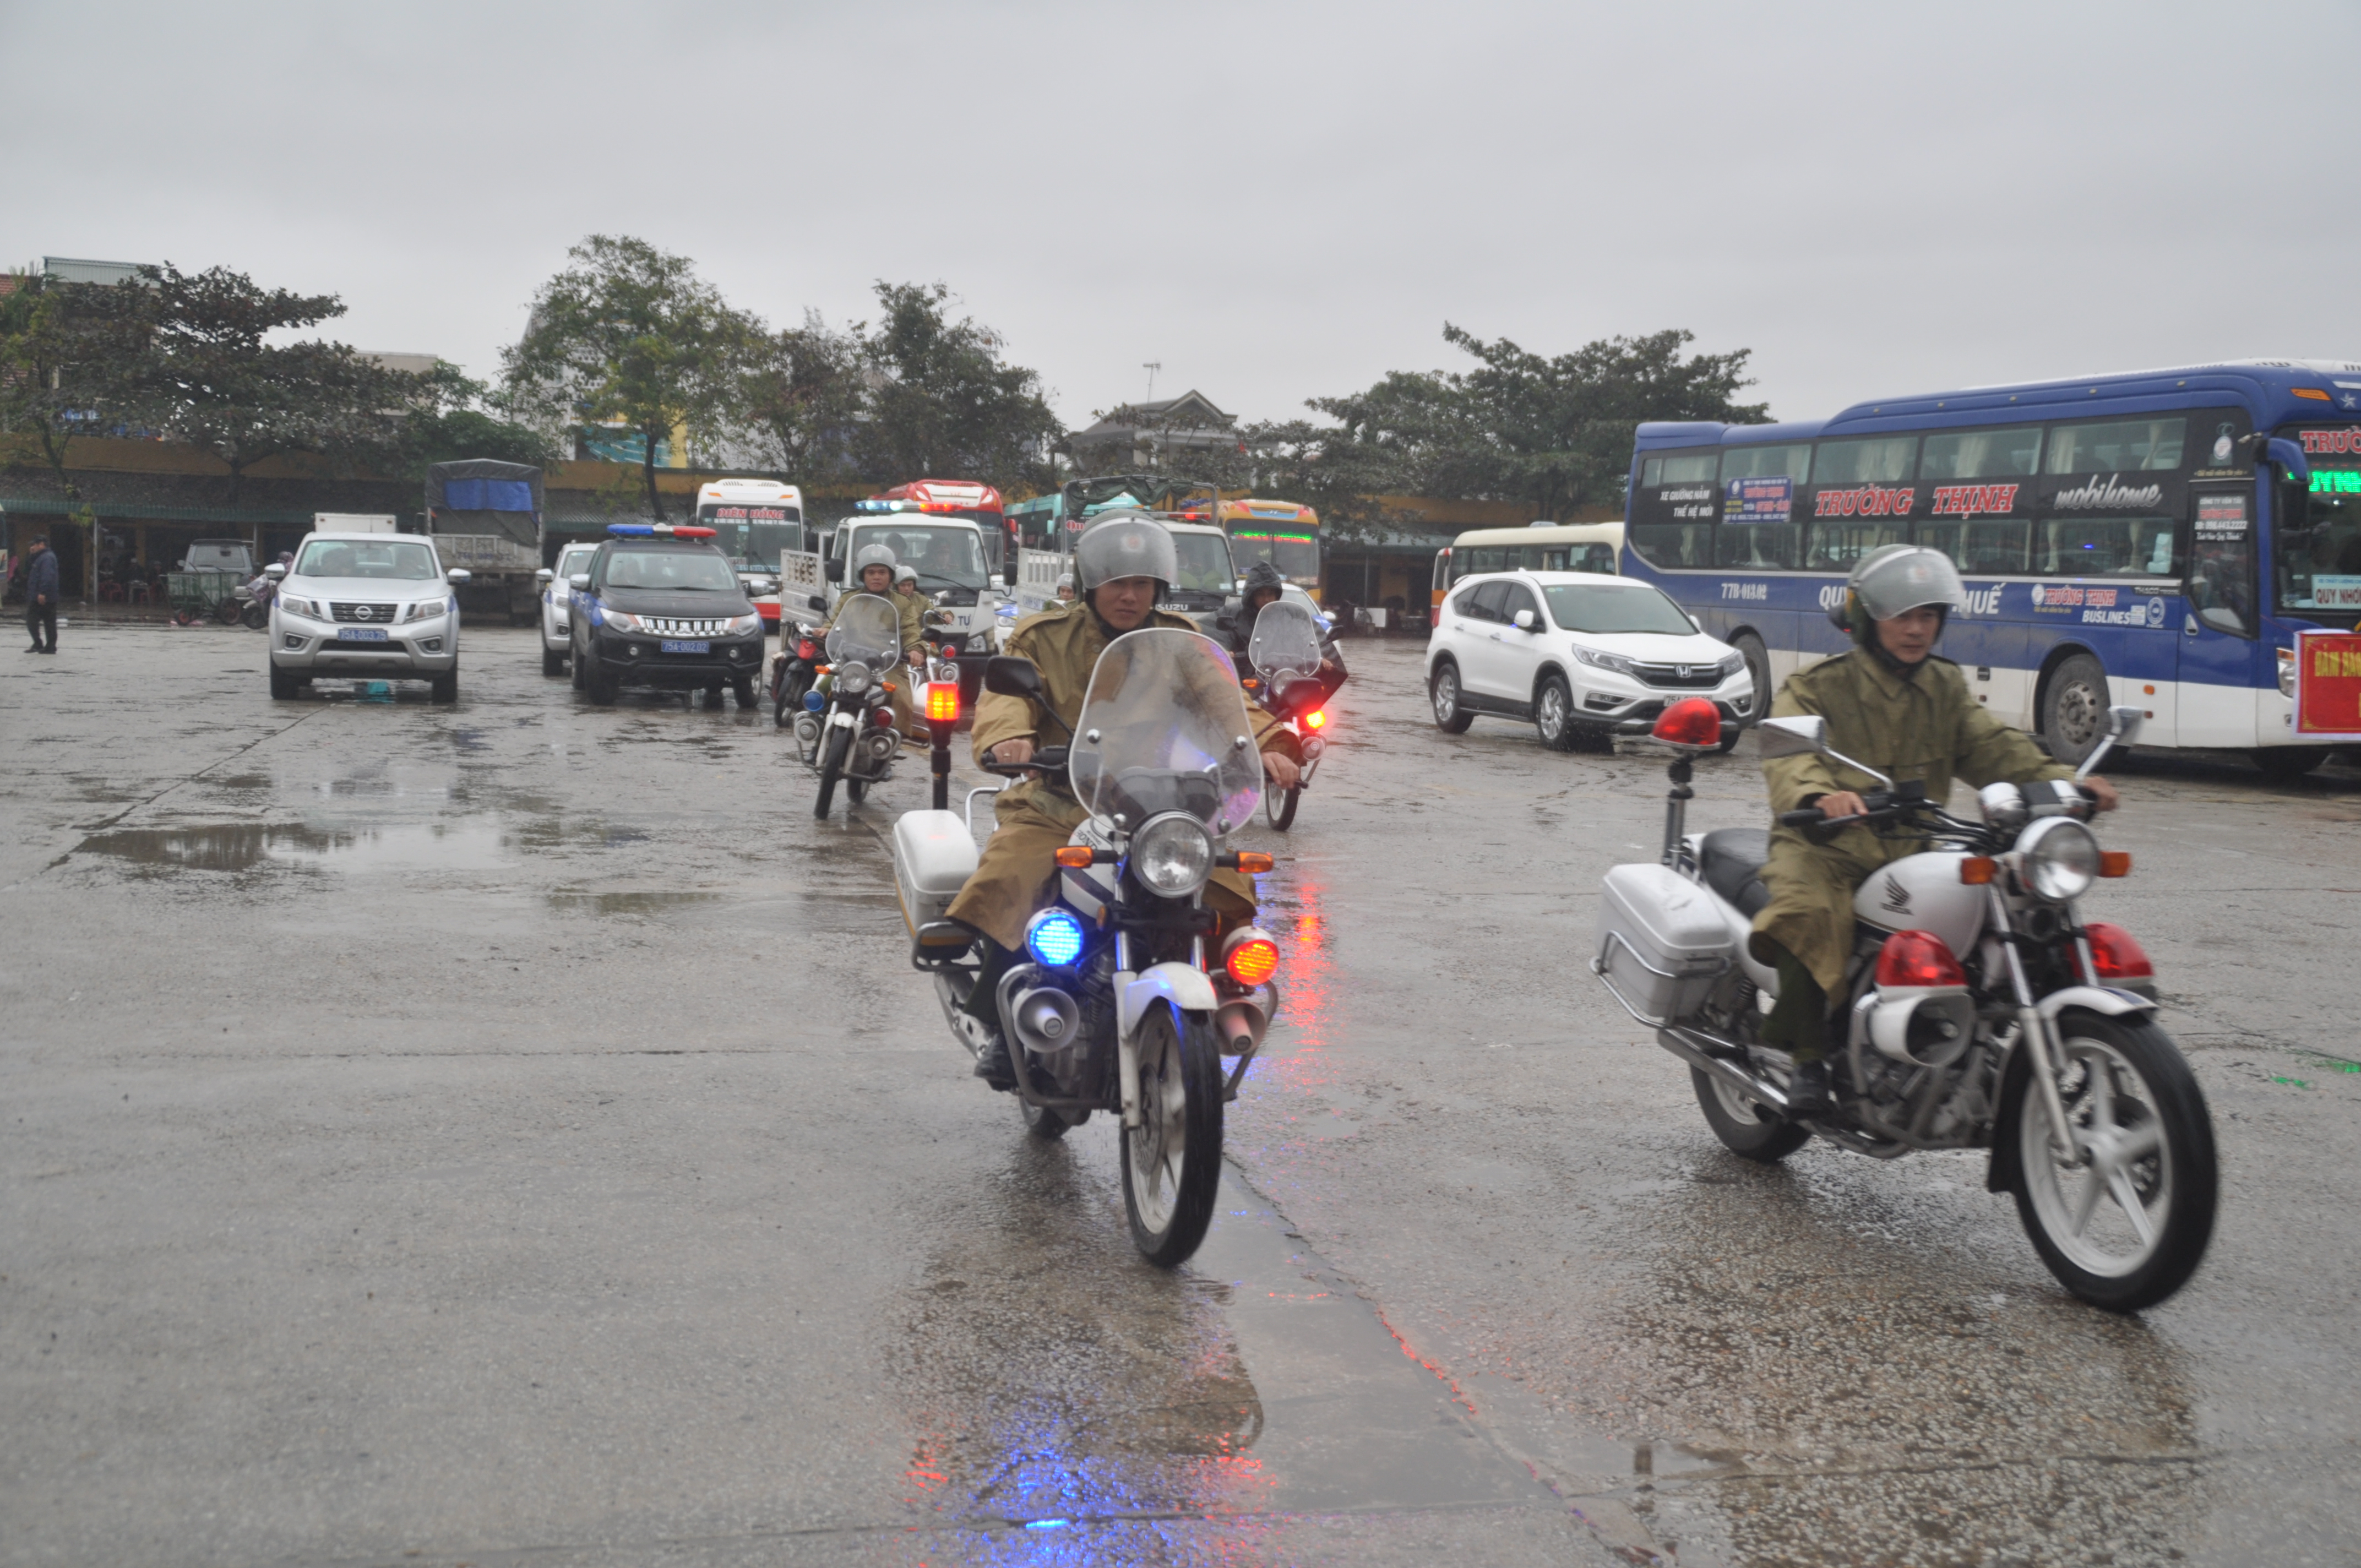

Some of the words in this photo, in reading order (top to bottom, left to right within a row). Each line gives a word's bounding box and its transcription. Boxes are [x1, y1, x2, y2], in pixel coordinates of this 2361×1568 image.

[1660, 491, 1669, 500] XE
[1815, 483, 1915, 516] TRƯỜNG
[1932, 483, 2019, 519] THỊNH
[2053, 473, 2162, 510] mobihome
[2082, 609, 2130, 624] BUSLINES
